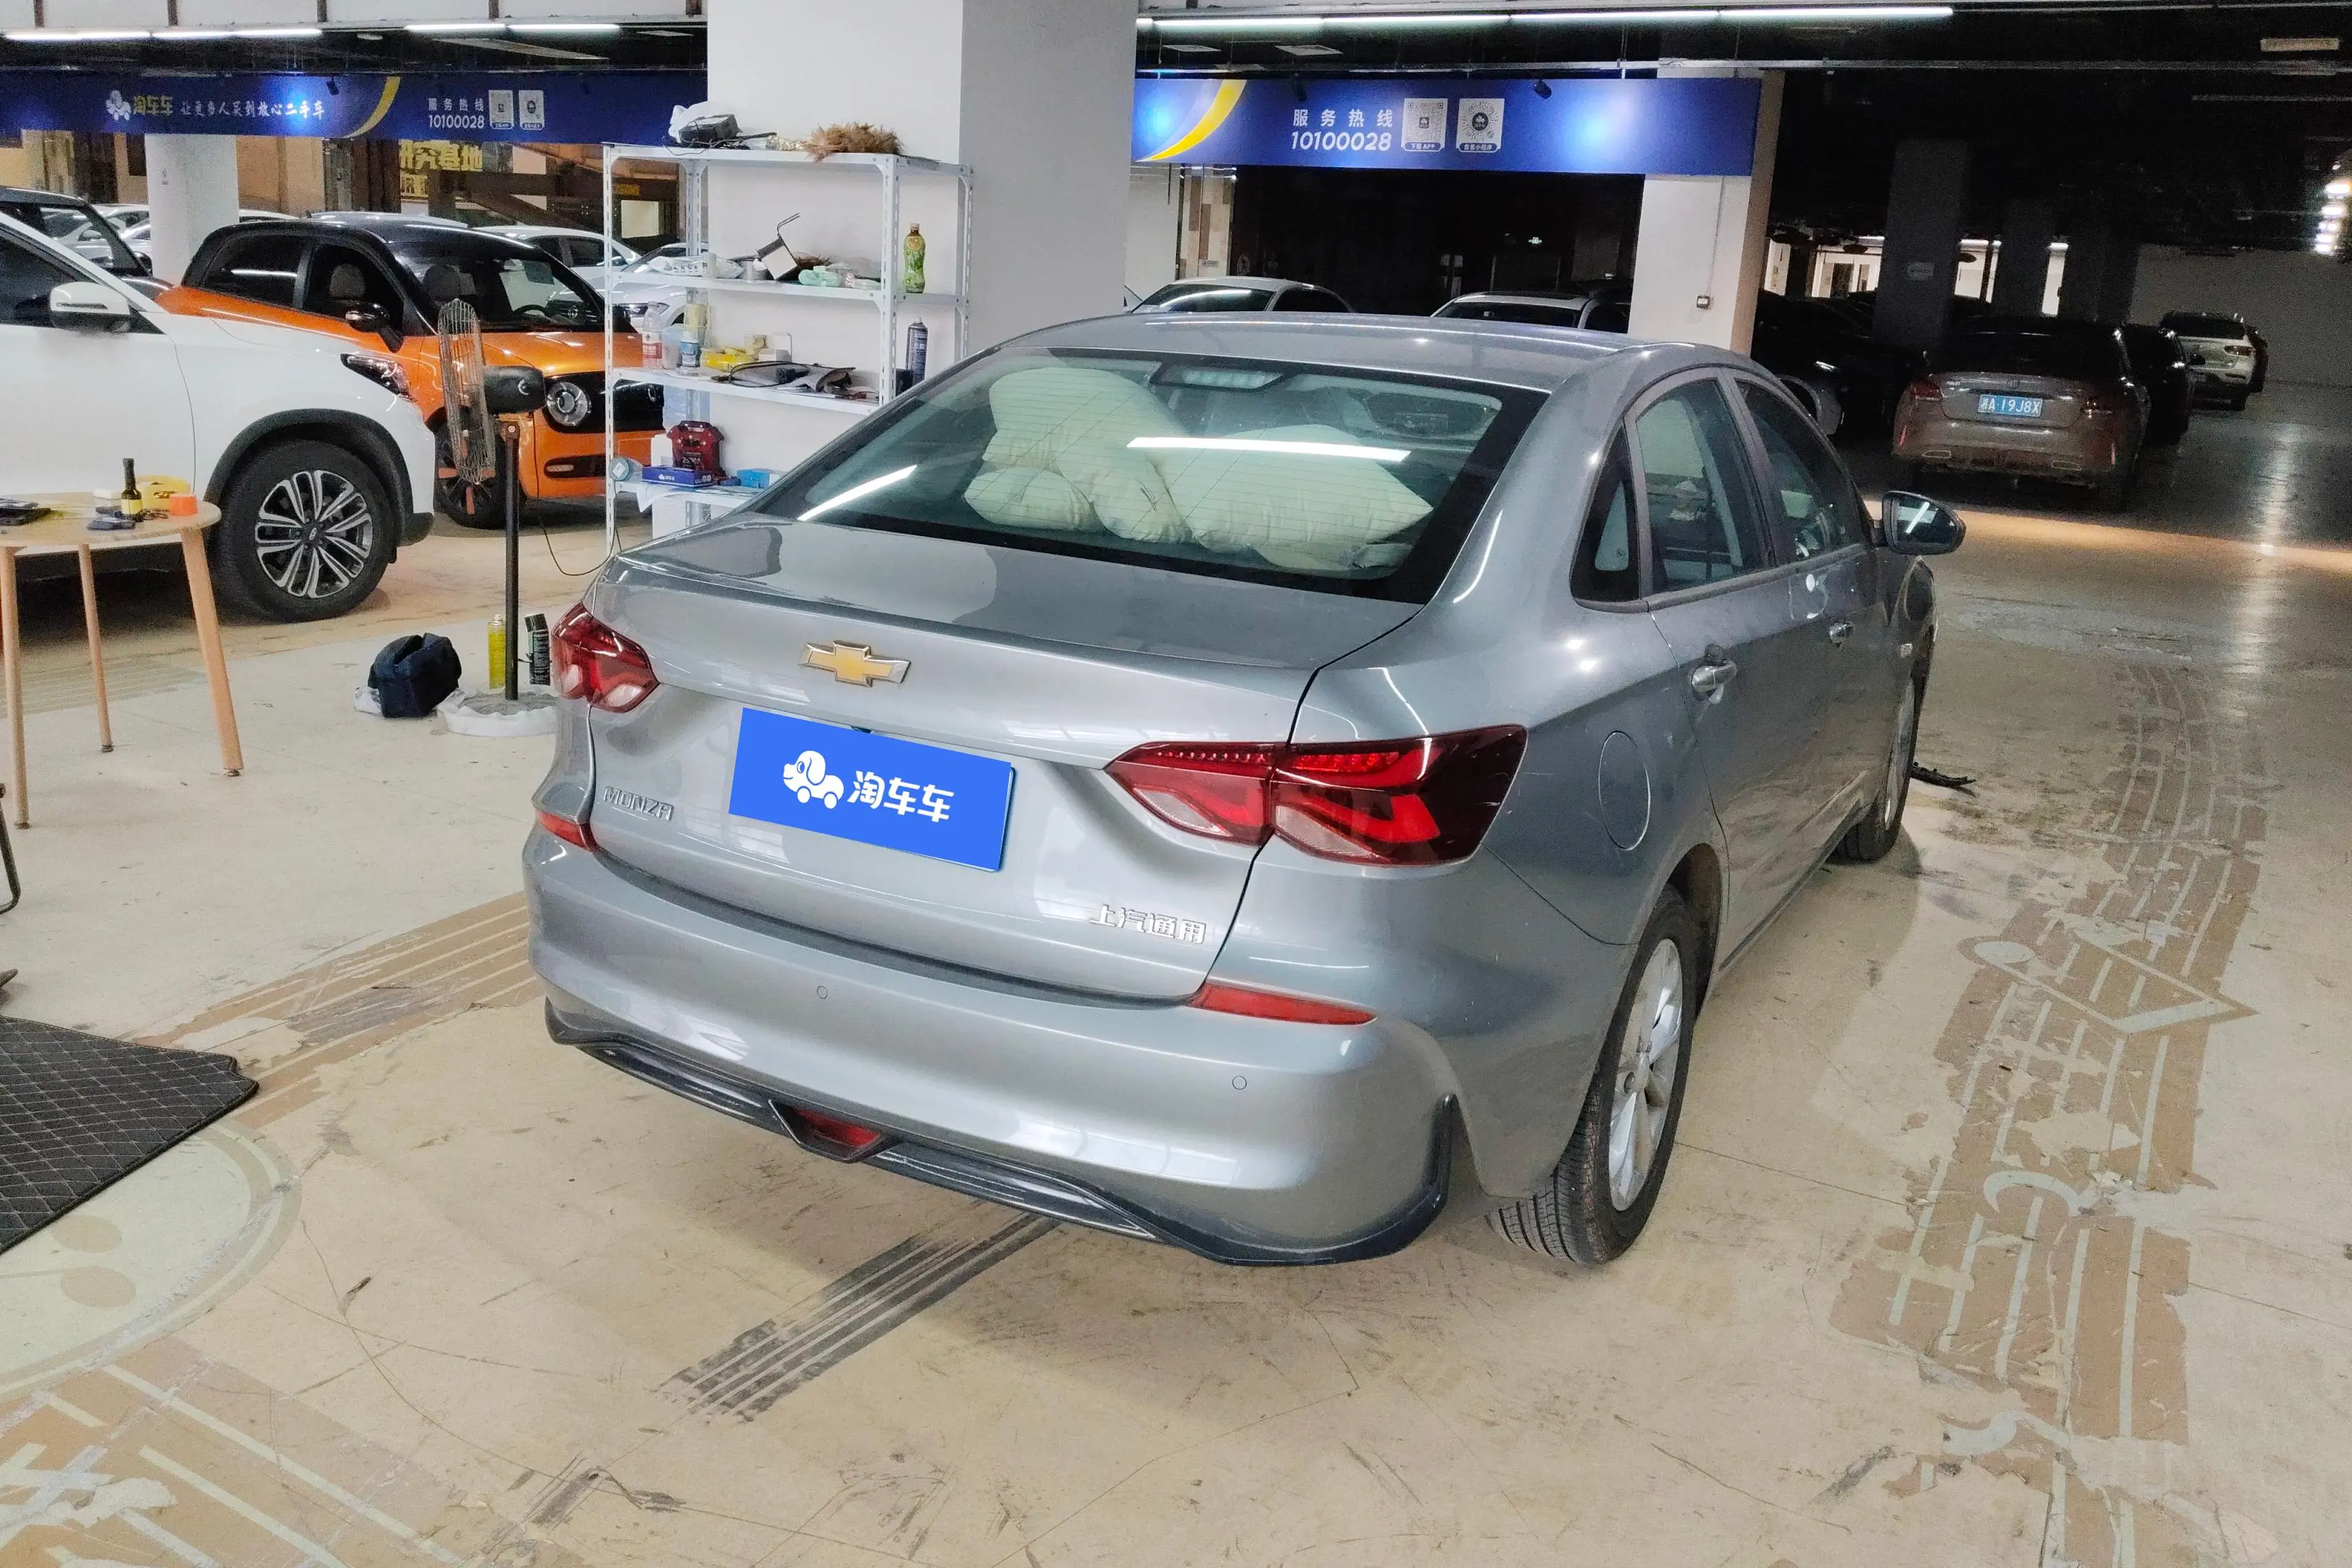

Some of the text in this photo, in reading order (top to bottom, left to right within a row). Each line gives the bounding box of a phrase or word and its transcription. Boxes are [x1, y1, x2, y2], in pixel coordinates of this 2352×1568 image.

[133, 94, 173, 116] 淘车车
[428, 97, 484, 112] 服务热线
[428, 115, 485, 129] 10100028
[1293, 109, 1393, 128] 服务热线
[1291, 131, 1392, 151] 10100028
[604, 786, 674, 821] MONZA
[1090, 904, 1207, 944] 上汽通用
